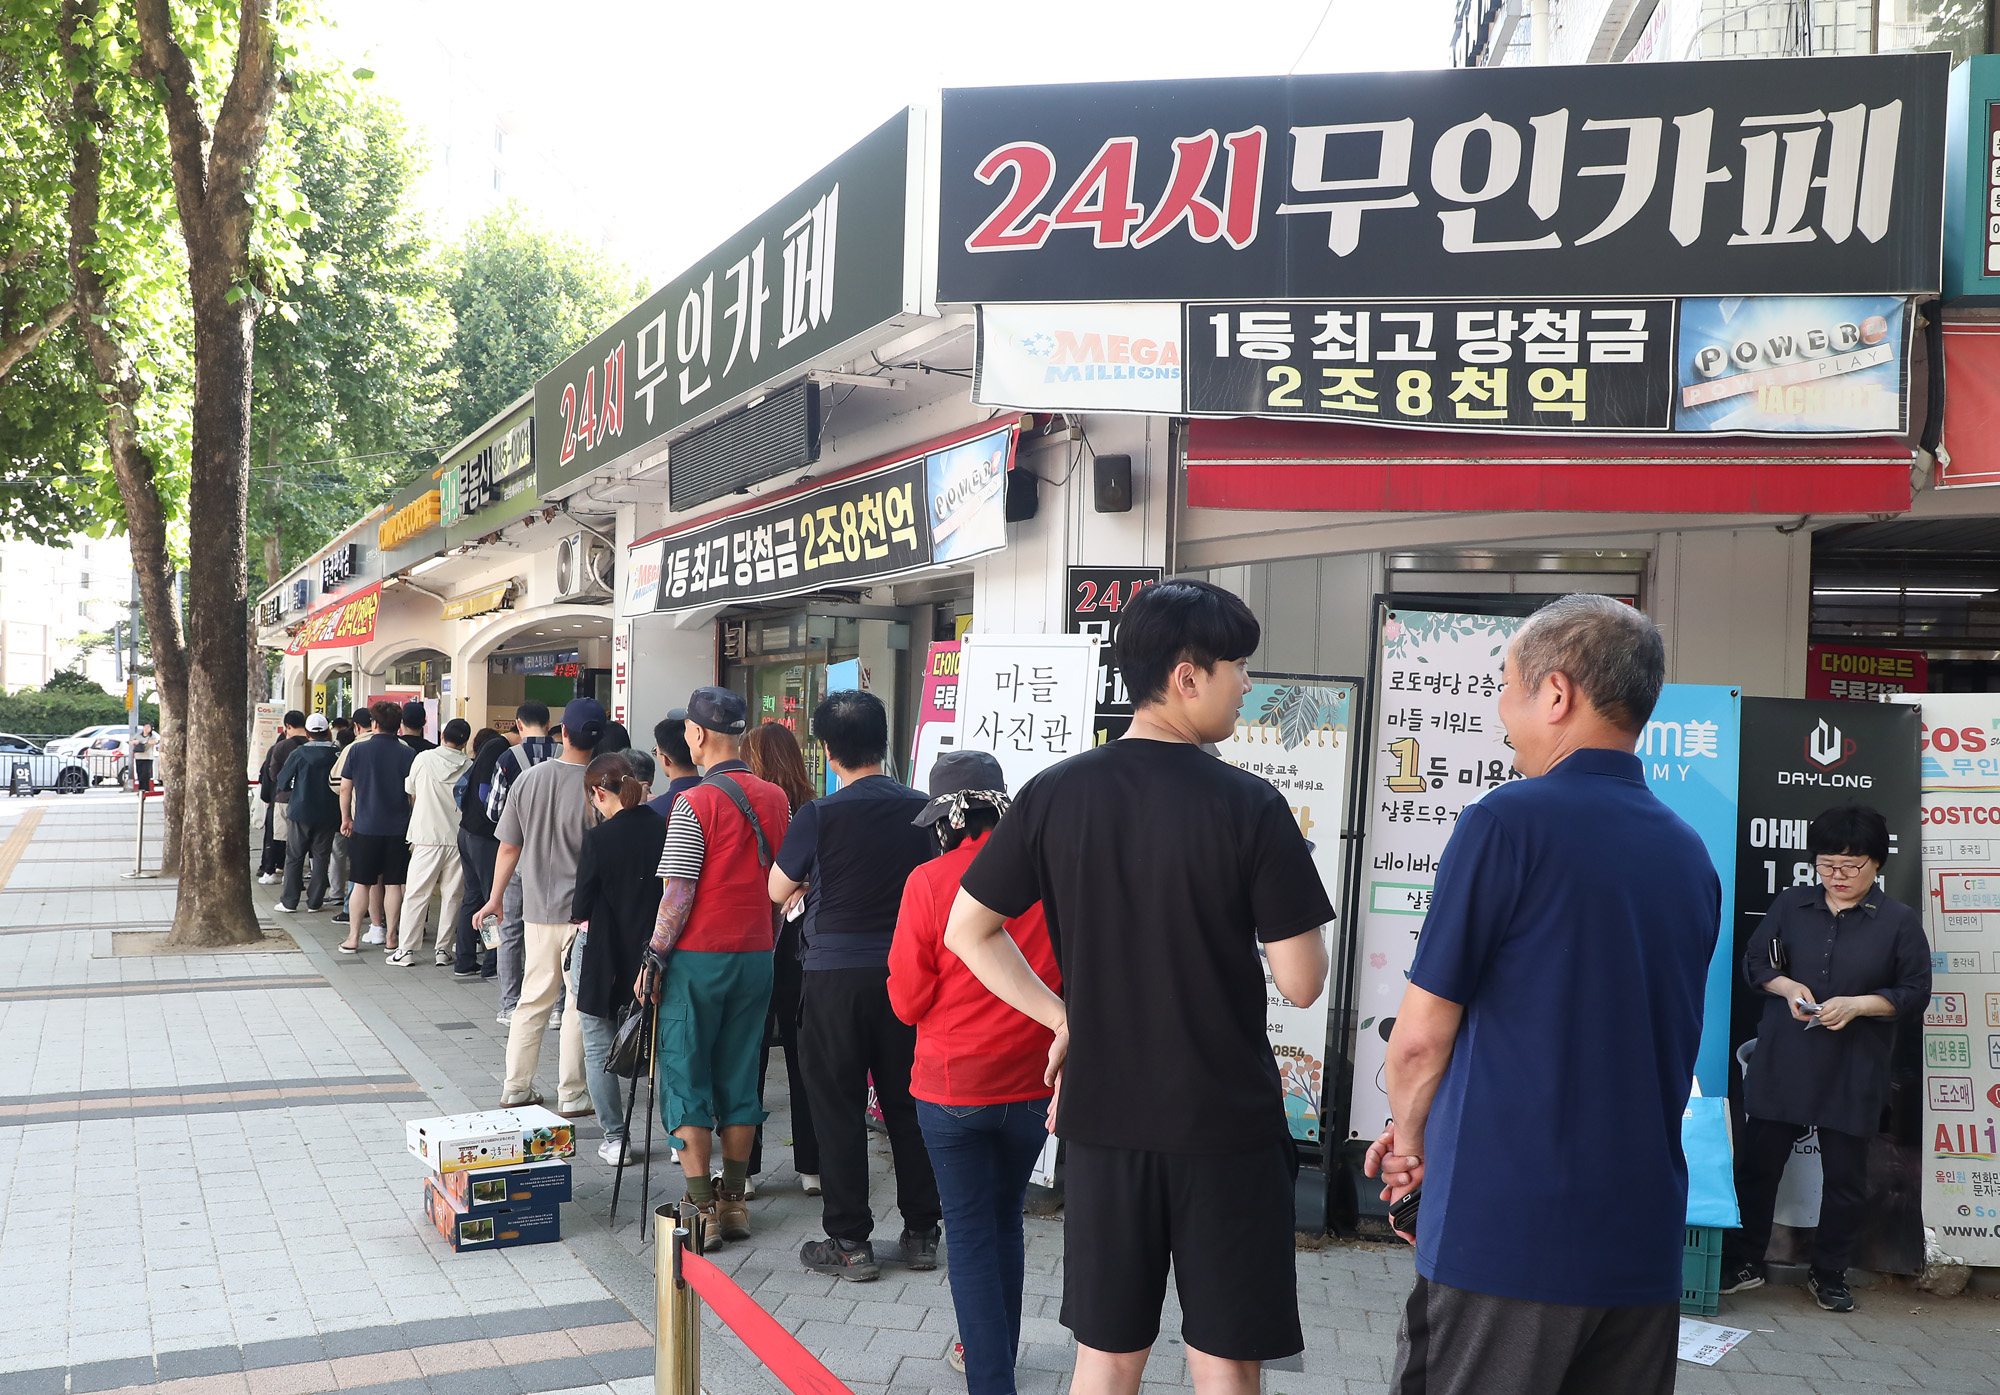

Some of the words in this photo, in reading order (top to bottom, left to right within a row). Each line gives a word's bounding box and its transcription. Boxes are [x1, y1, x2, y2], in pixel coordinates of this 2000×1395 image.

[1208, 312, 1298, 363] 1등
[1311, 310, 1434, 365] 최고
[1456, 304, 1650, 366] 당첨금
[1048, 330, 1180, 366] MEGA
[1818, 350, 1878, 375] PLAY
[1044, 365, 1181, 384] MILLIONS
[665, 549, 689, 599] 1등
[690, 537, 729, 593] 최고
[733, 518, 799, 586] 당첨금
[1821, 653, 1914, 678] 다이아몬드
[995, 664, 1058, 704] 마들
[1389, 671, 1462, 697] 로또명당
[1388, 708, 1424, 732] 마들
[1430, 710, 1484, 734] 키워드
[972, 711, 1073, 754] 사진관
[1253, 762, 1299, 777] 미술교육
[1642, 763, 1691, 782] MY
[1778, 770, 1873, 789] DAYLONG
[1294, 779, 1325, 791] 배워요
[1959, 844, 1981, 855] 중국집
[1948, 916, 1978, 926] 인테리어
[1272, 1044, 1306, 1058] 0854
[1935, 1170, 1967, 1184] 올인원
